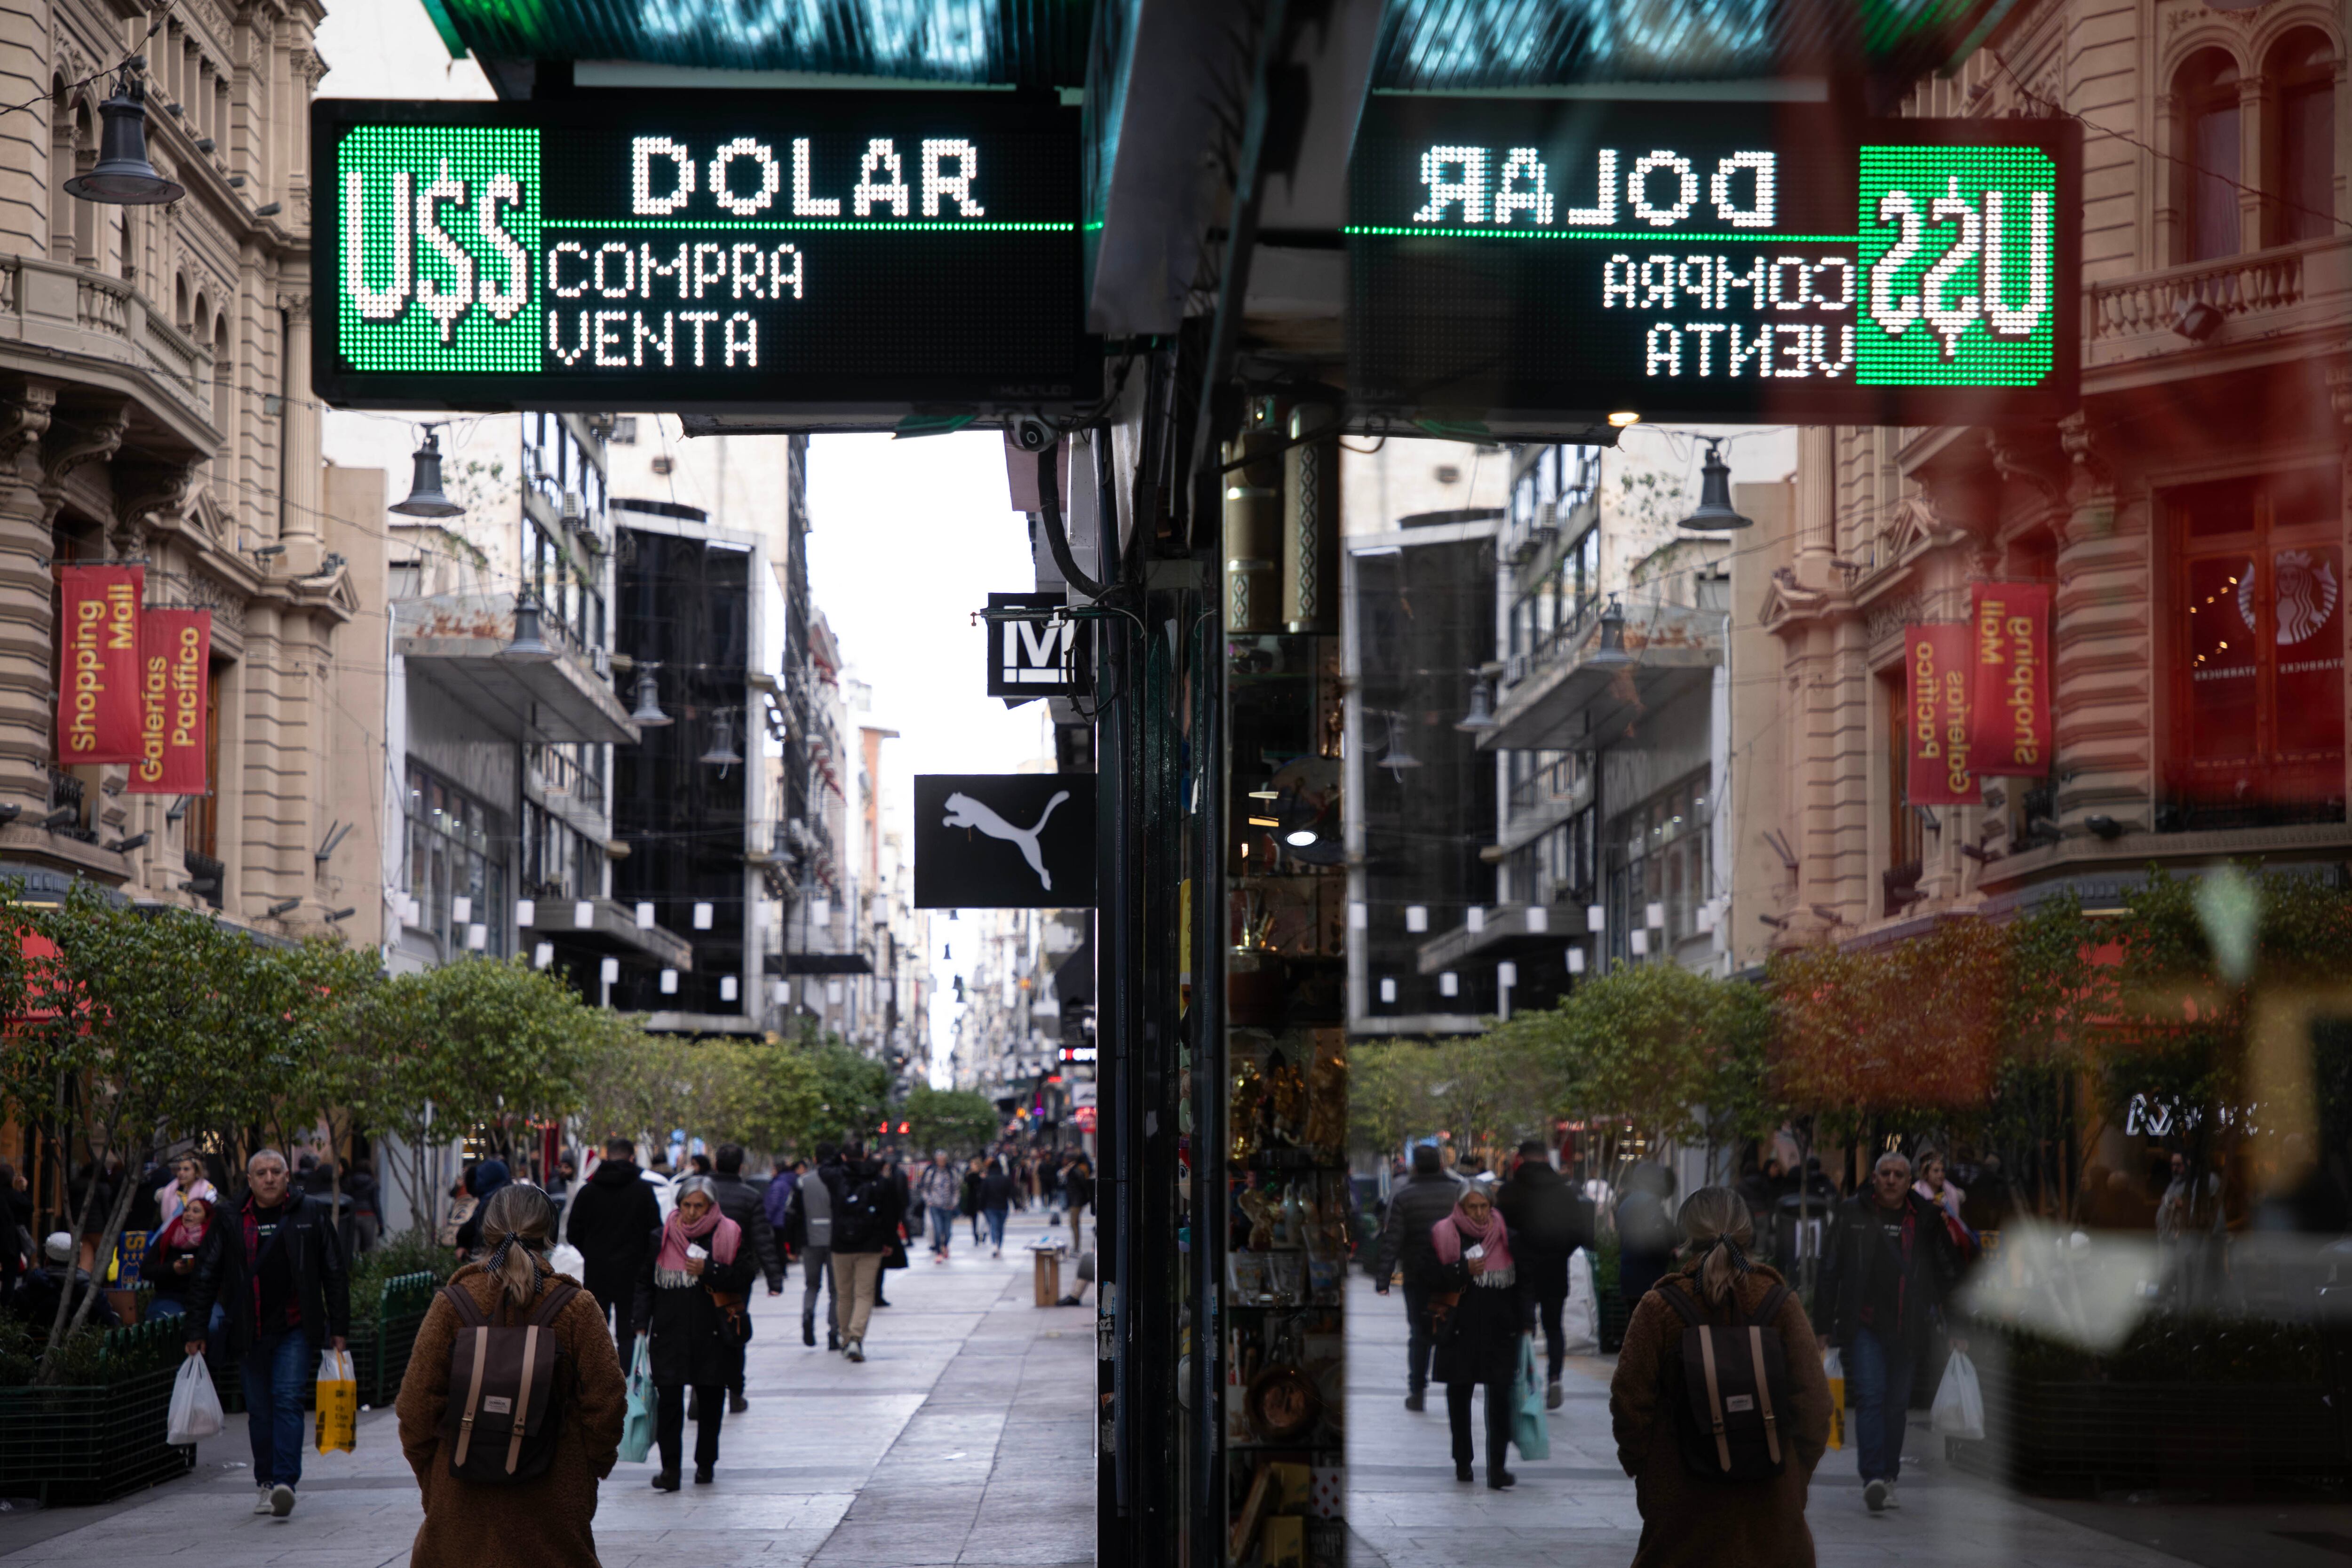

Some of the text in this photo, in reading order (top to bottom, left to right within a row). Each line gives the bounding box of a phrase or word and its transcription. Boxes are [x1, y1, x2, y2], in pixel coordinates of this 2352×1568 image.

[632, 136, 985, 216] DOLAR
[548, 241, 803, 299] COMPRA
[548, 310, 758, 367] VENTA
[108, 584, 134, 649] Mall
[70, 600, 106, 752] Shopping
[173, 627, 199, 746] Pacífico
[140, 656, 167, 782] Galerías
